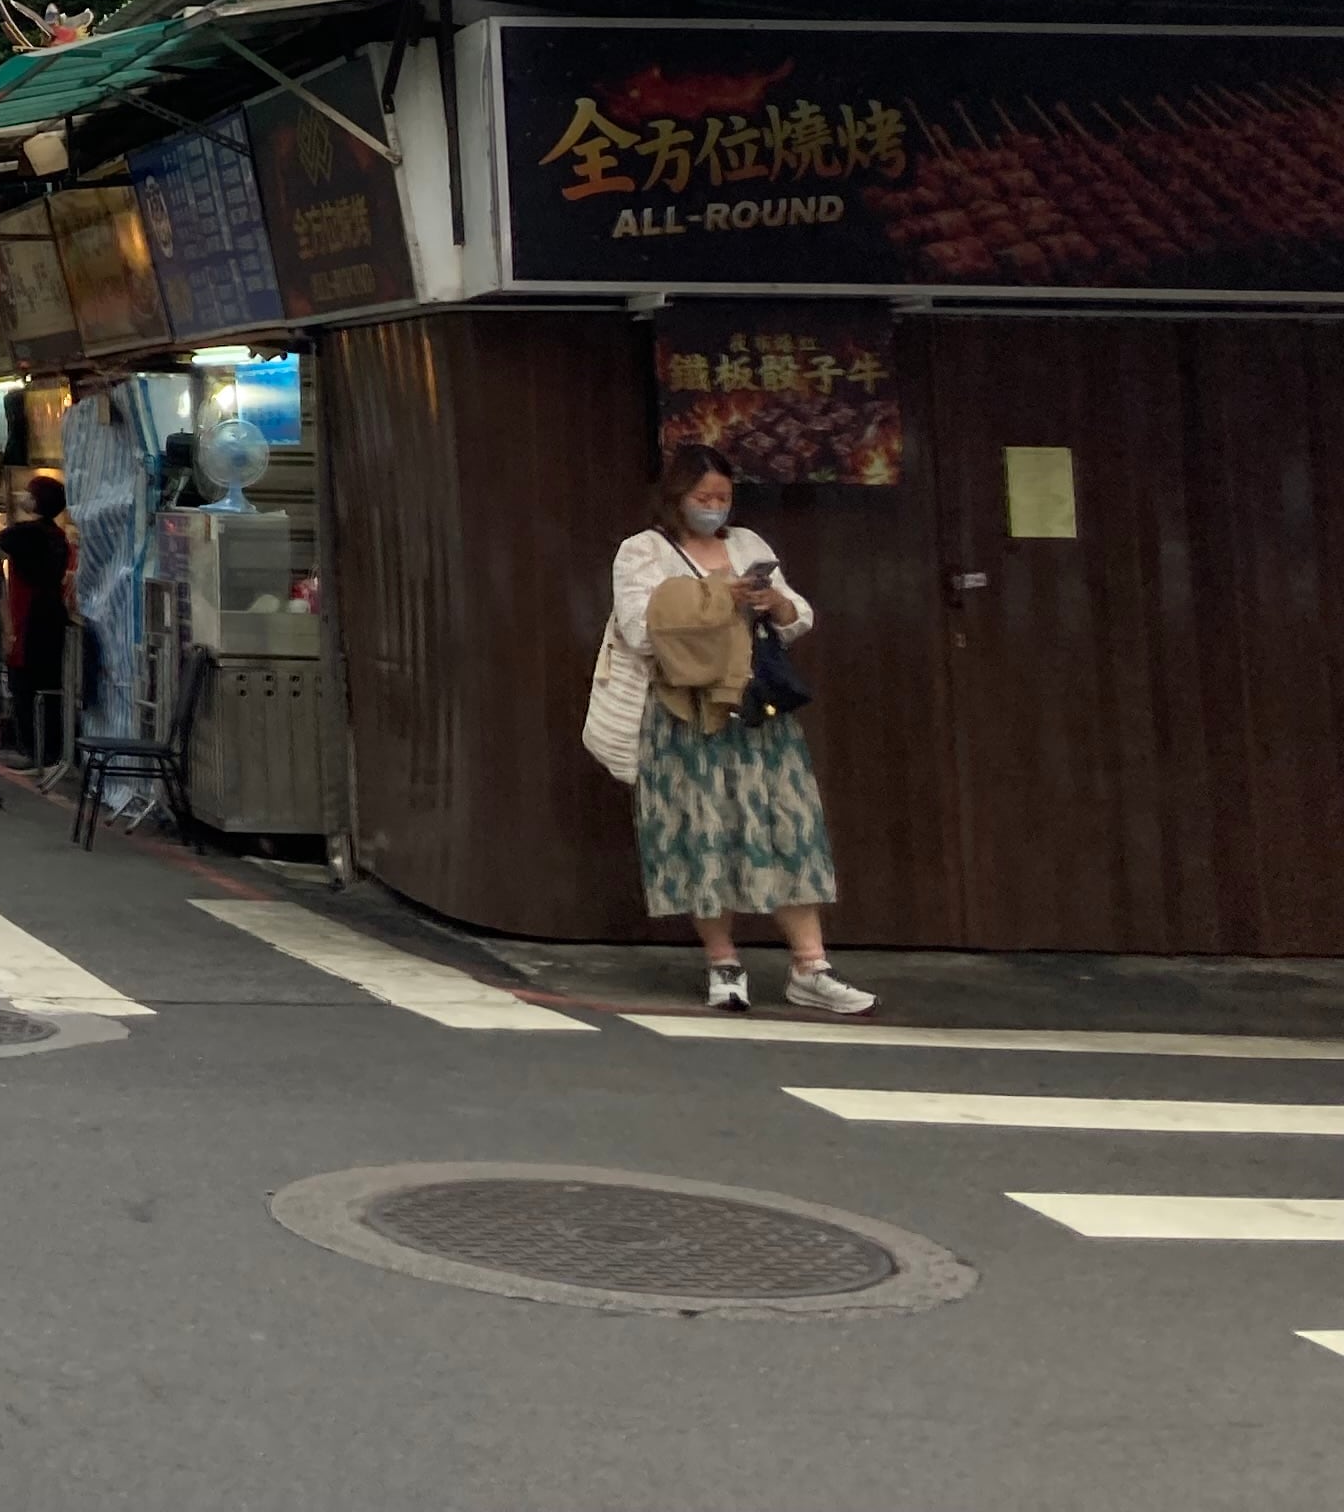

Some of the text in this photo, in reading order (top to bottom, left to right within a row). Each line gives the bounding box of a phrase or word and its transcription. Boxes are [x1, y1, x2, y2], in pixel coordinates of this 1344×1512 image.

[537, 95, 909, 202] 全方位燒烤
[612, 193, 845, 240] ALL-ROUND
